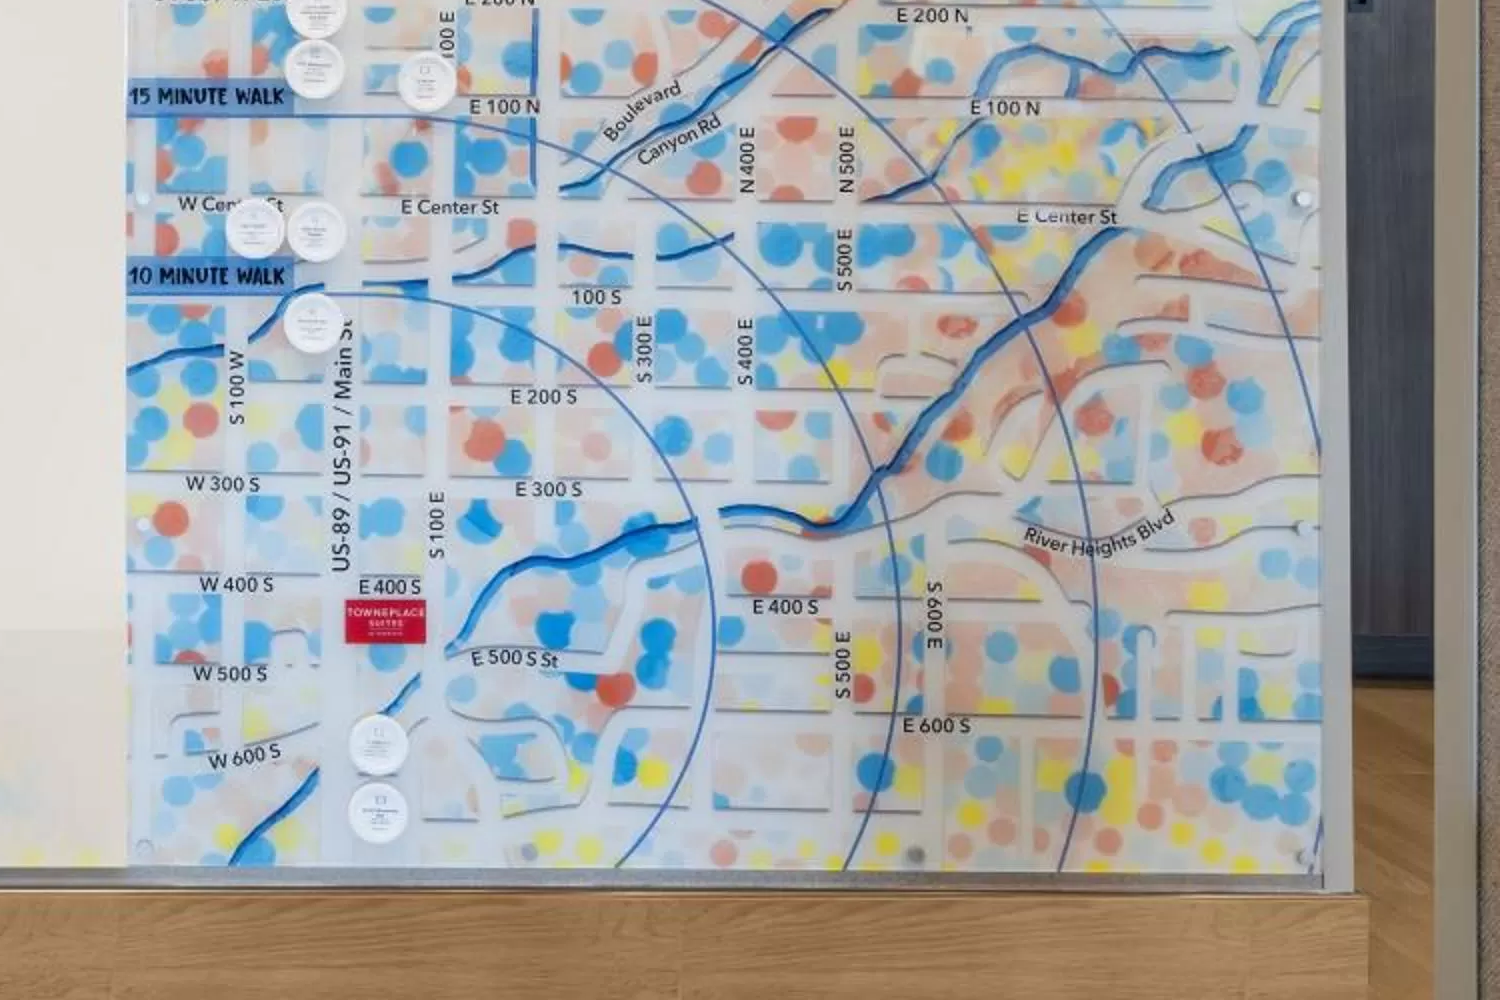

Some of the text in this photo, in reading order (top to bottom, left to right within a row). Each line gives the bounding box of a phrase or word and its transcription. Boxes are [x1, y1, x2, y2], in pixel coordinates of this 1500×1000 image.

[440, 12, 454, 22] E
[897, 8, 968, 23] E 200 N
[129, 87, 284, 105] 15 MINUTE WALK
[603, 80, 682, 142] Boulevard
[971, 101, 1040, 116] E 100 N
[637, 112, 721, 165] Canyon Rd
[740, 127, 755, 194] N 400 E
[178, 196, 197, 211] W
[401, 200, 499, 214] E Center St
[1100, 209, 1117, 225] St
[838, 230, 853, 291] S 500 E
[129, 267, 285, 285] 10 MINUTE WALK
[573, 289, 621, 305] 100 S
[638, 316, 652, 383] S 300 E
[334, 347, 352, 399] Main
[230, 350, 244, 425] S 100 W
[511, 390, 577, 405] E 200 S
[333, 424, 351, 486] US-91
[186, 476, 260, 492] W 300 S
[429, 492, 444, 558] S 100 E
[1024, 508, 1175, 559] River Heights Blvd
[332, 507, 350, 572] US-89
[359, 579, 421, 594] E 400 S
[347, 607, 424, 617] TOWNEPLACE
[753, 600, 819, 614] E 400 S
[928, 581, 942, 649] S 600 E
[472, 650, 559, 669] E 500 S St
[903, 719, 971, 733] E 600 S
[208, 744, 281, 771] W 600 S
